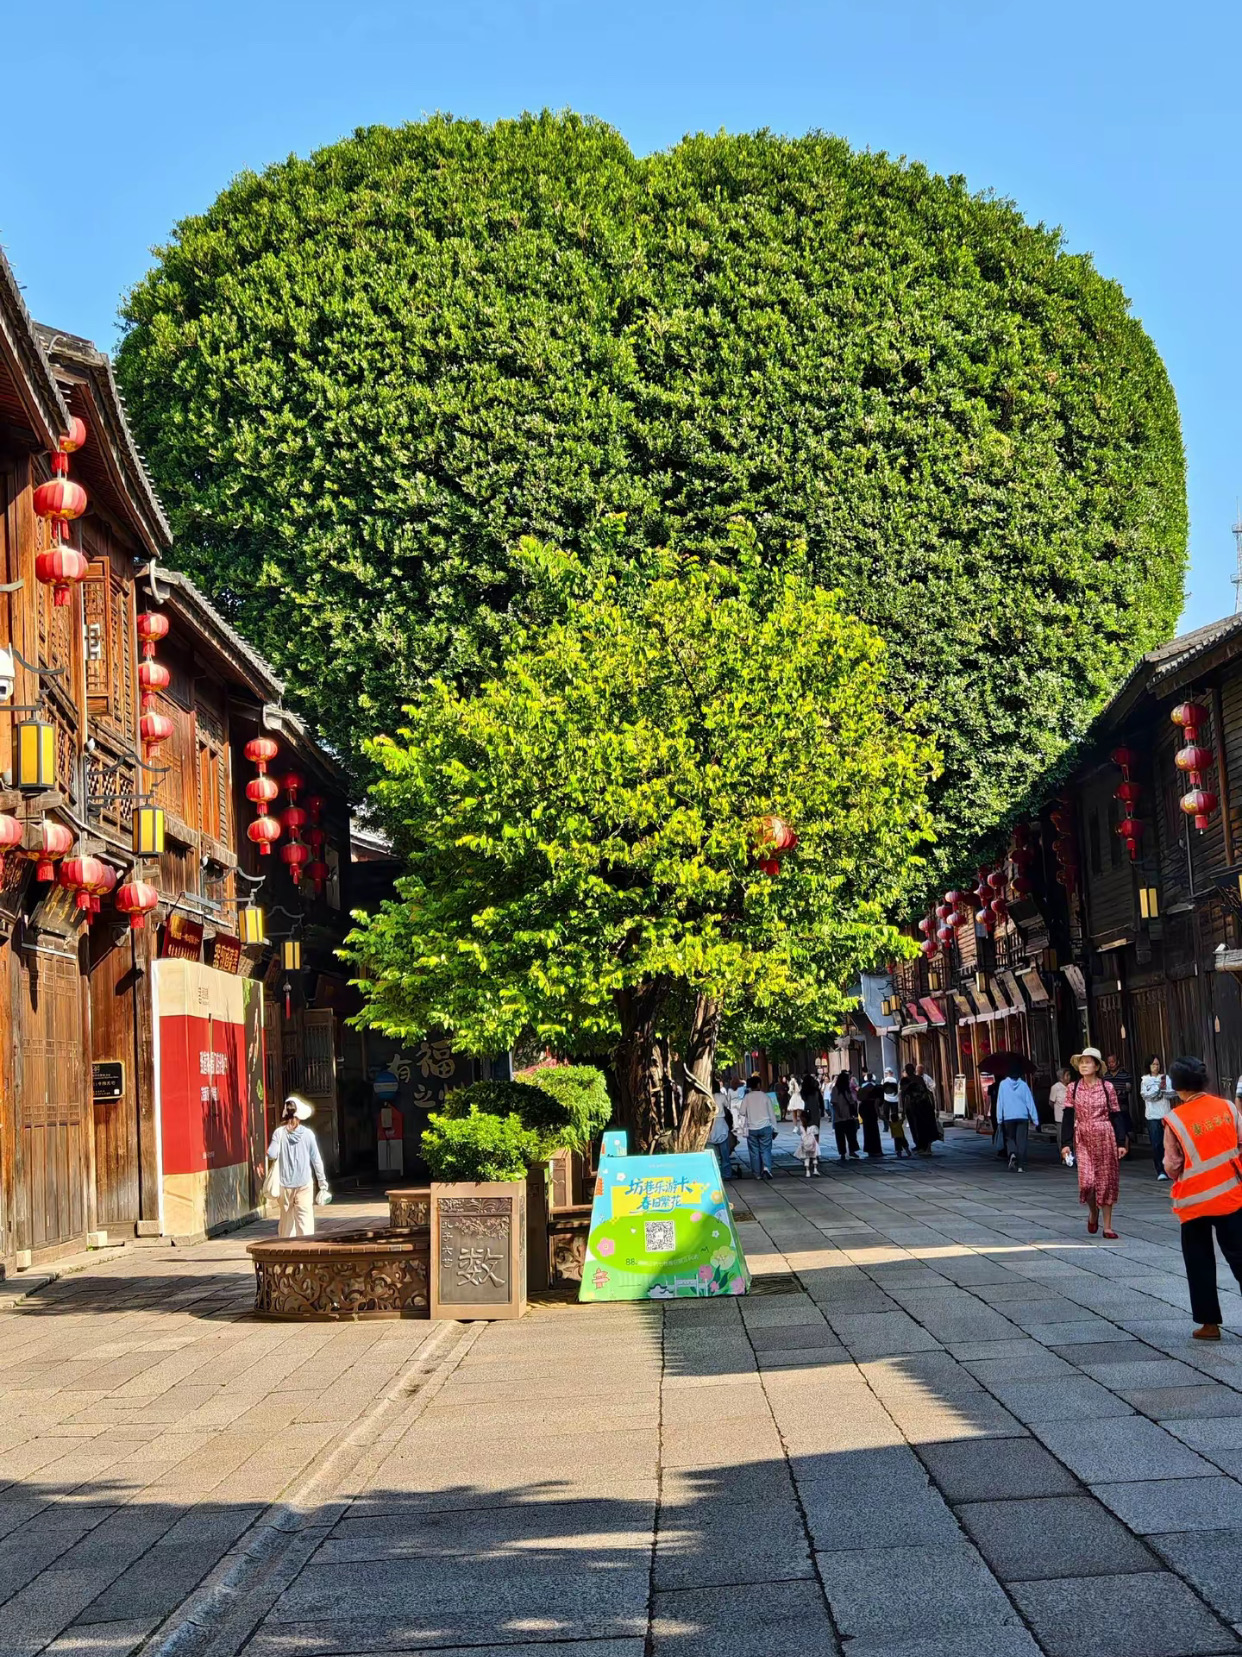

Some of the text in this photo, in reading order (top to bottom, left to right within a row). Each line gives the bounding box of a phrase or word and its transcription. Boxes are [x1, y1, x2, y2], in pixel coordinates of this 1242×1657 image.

[624, 1176, 694, 1196] 坊巷乐游卡
[456, 1247, 506, 1288] 数
